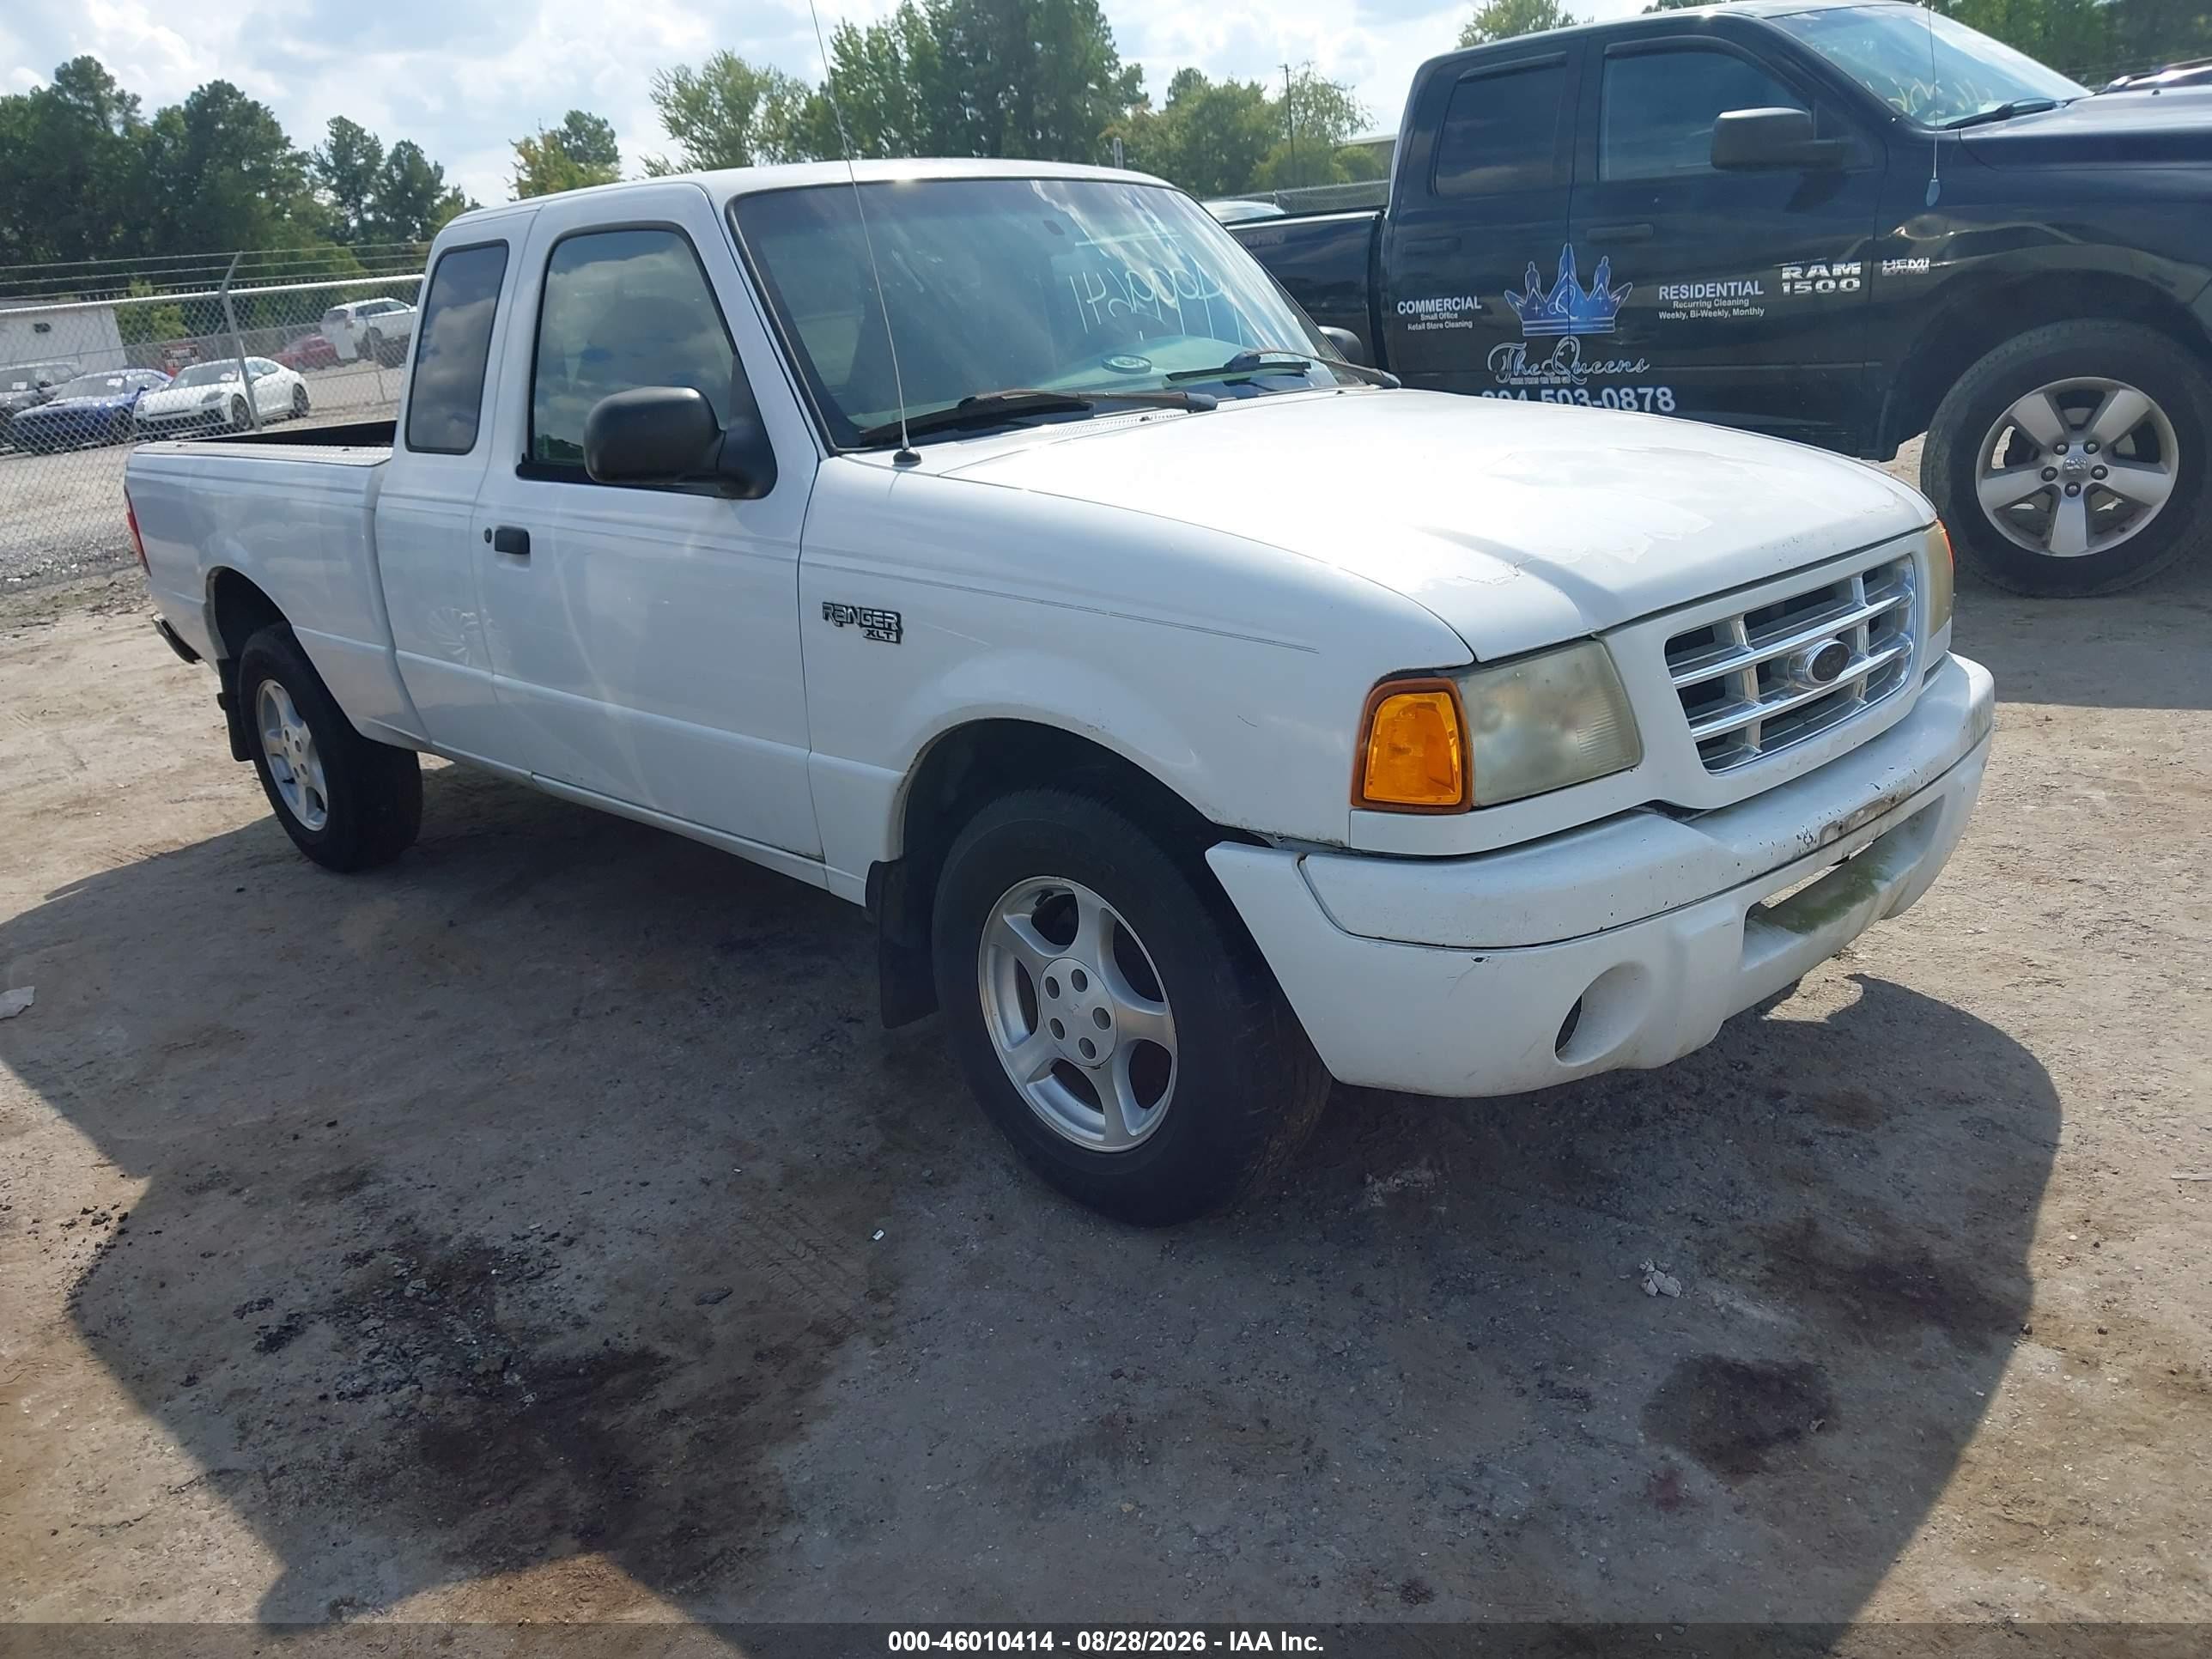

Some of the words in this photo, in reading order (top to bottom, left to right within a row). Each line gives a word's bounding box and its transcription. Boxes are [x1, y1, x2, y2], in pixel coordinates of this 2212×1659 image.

[1781, 261, 1862, 280] RAM
[1658, 280, 1765, 301] RESIDENTIAL
[1782, 277, 1861, 296] 1500
[1397, 295, 1482, 314] COMMERCIAL
[1673, 300, 1712, 309] Recurring
[1713, 297, 1749, 307] Cleaning
[1420, 313, 1438, 321] Small
[1438, 312, 1458, 320] Office
[1658, 310, 1688, 320] Weekly,
[1689, 308, 1731, 319] Bi-Weekly,
[1732, 306, 1765, 317] Monthly
[1426, 321, 1443, 330] Store
[1444, 319, 1473, 329] Cleaning
[1487, 342, 1541, 385] The
[1541, 336, 1650, 386] Queens
[822, 601, 902, 632] RANGER
[865, 629, 894, 641] XLT
